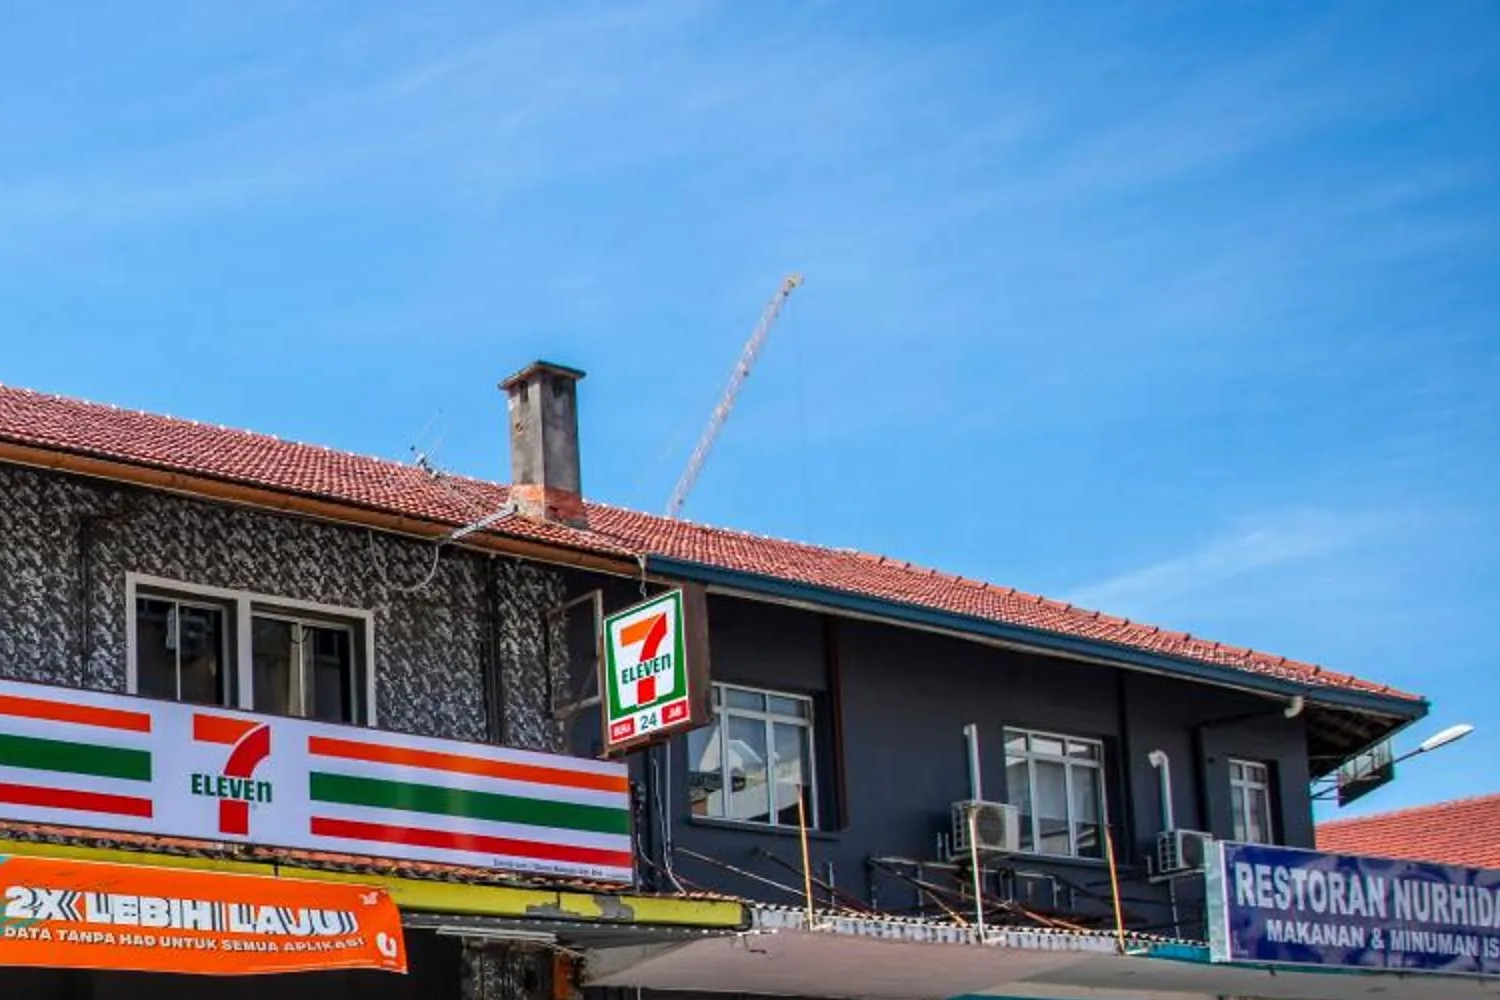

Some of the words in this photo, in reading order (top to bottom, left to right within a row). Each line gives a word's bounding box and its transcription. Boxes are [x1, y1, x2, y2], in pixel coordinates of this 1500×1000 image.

[621, 613, 667, 704] 7
[640, 712, 658, 730] 24
[193, 713, 271, 835] 7
[1235, 862, 1386, 917] RESTORAN
[85, 891, 216, 933] LEBIH
[228, 903, 359, 937] LAJU
[3, 925, 52, 942] DATA
[57, 928, 115, 945] TANPA
[159, 934, 217, 951] UNTUK
[221, 938, 278, 952] SEMUA
[282, 937, 364, 953] APLIKASI
[1267, 919, 1365, 948] MAKANAN
[1371, 927, 1385, 949] &
[1391, 930, 1479, 957] MINUMAN
